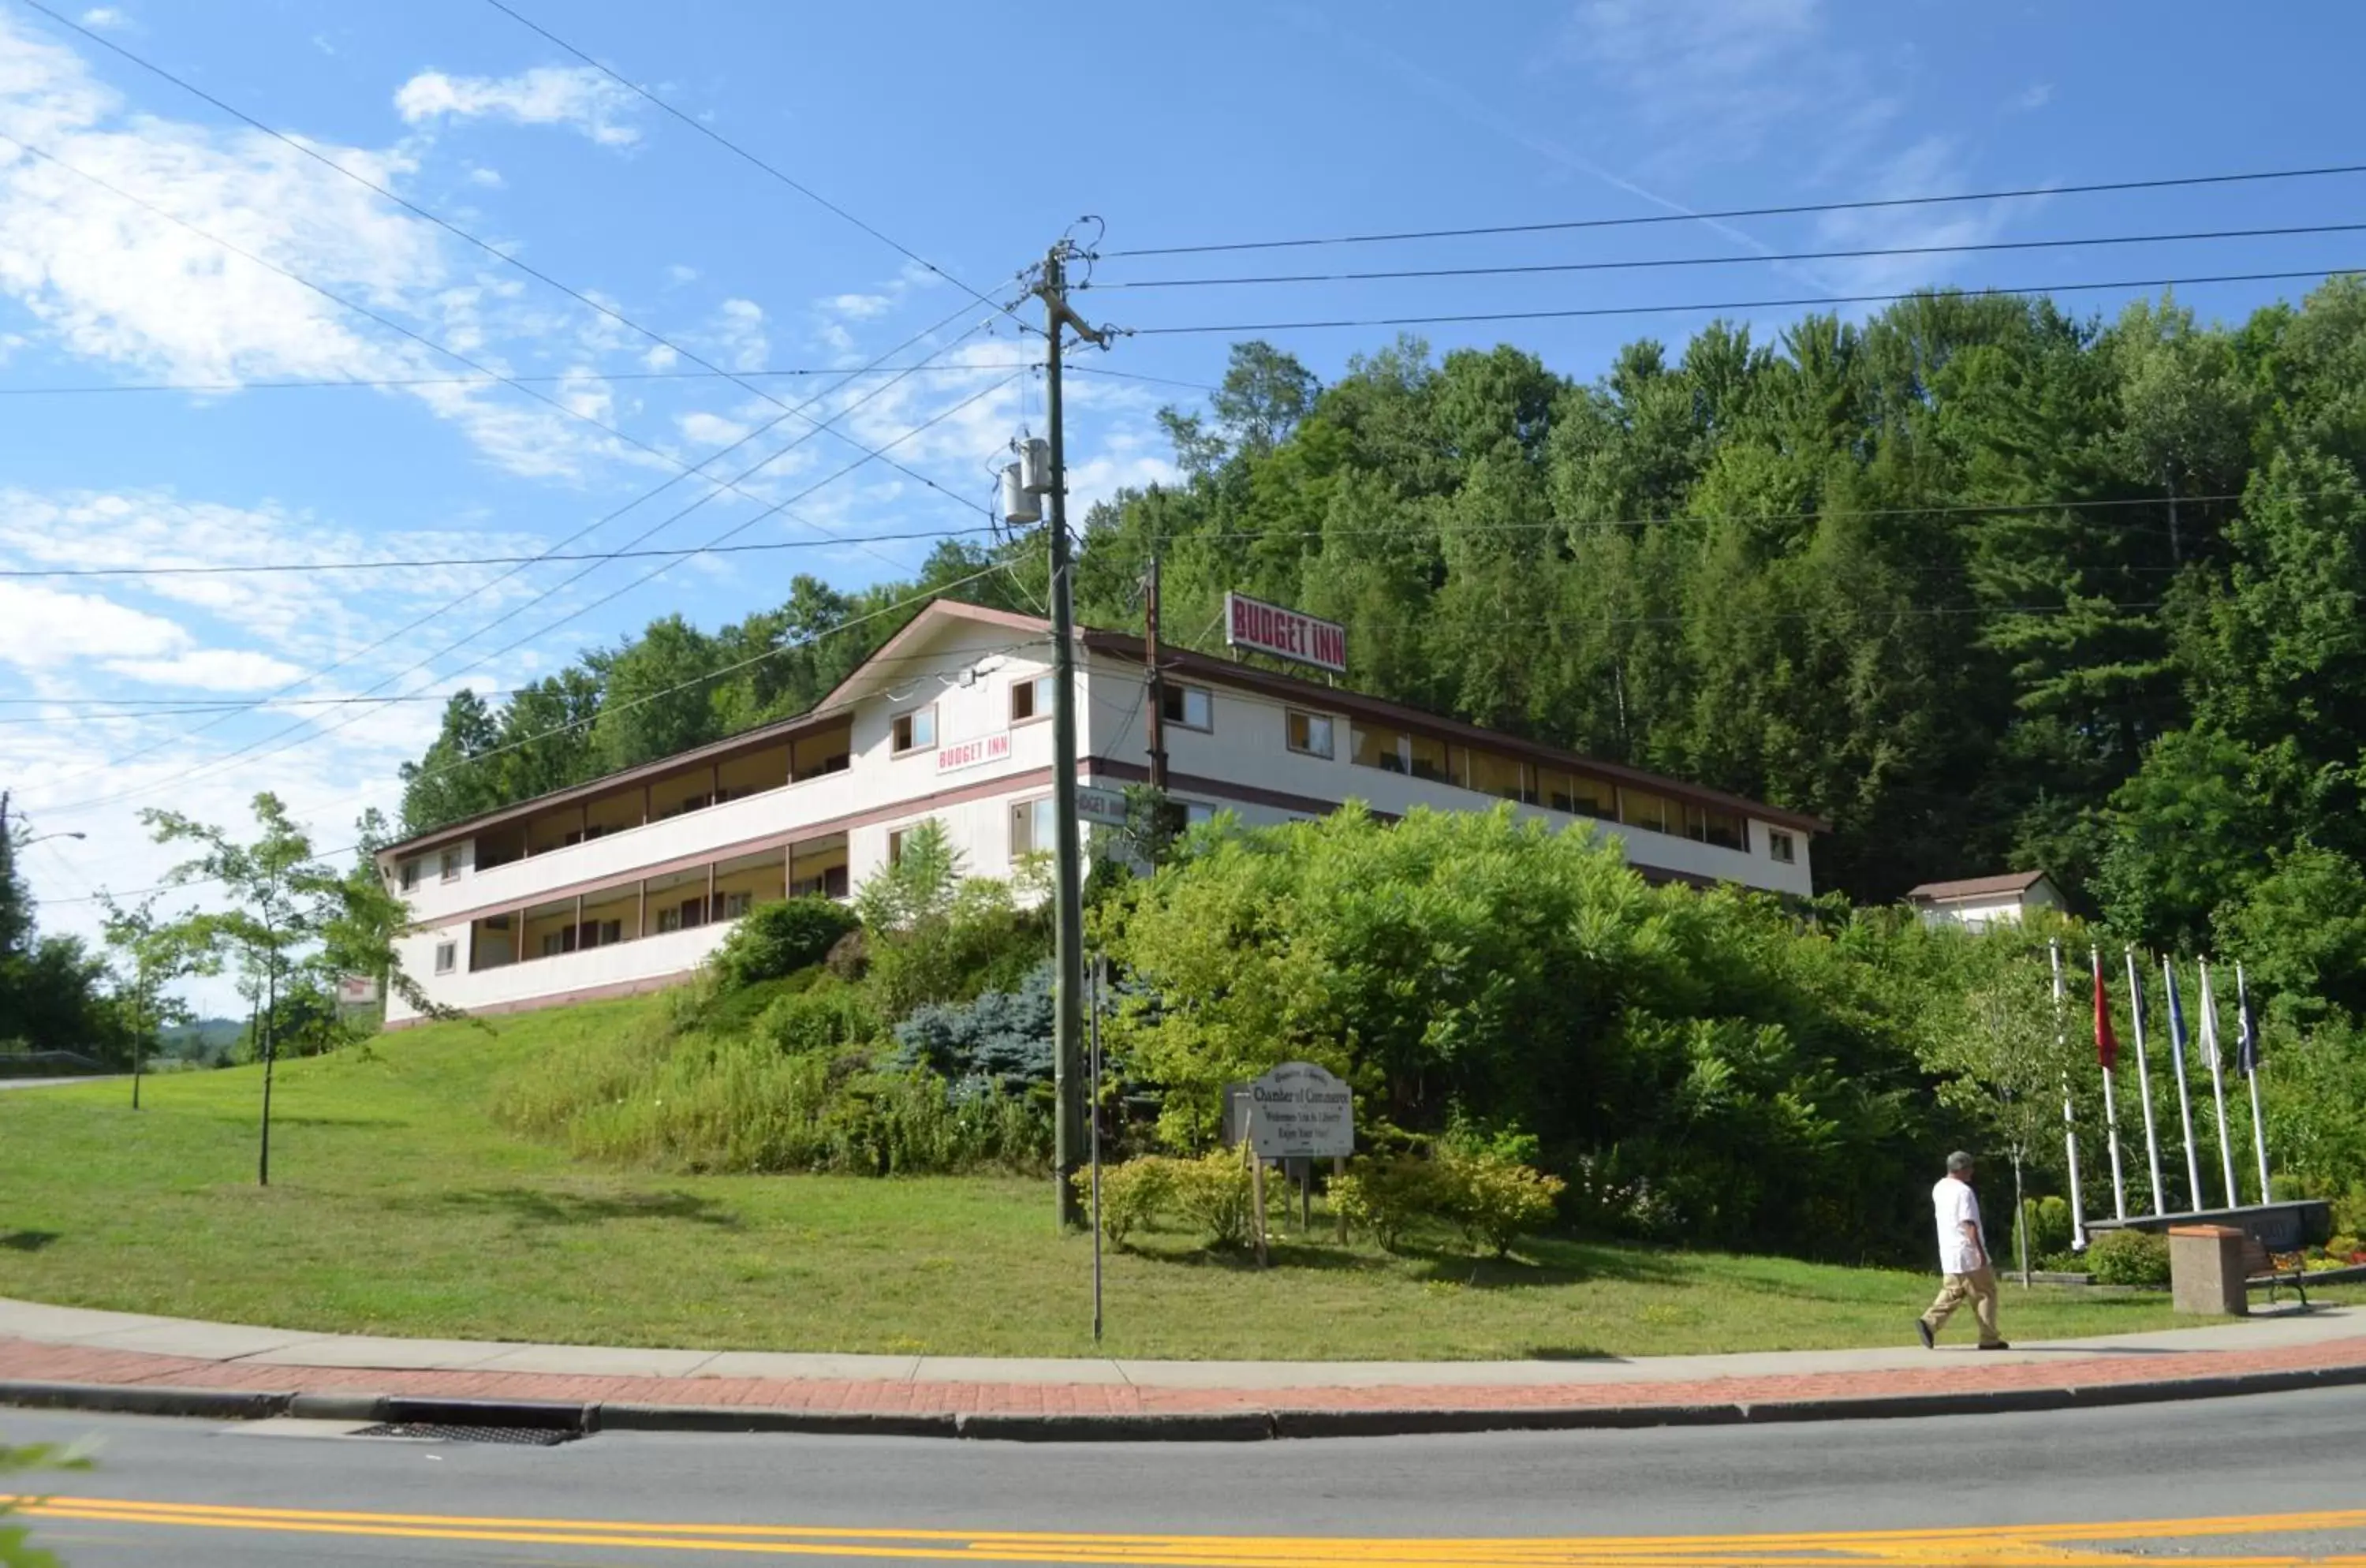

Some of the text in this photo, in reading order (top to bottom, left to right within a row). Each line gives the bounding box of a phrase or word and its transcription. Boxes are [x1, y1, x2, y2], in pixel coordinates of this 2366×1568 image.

[1234, 599, 1345, 666] BUDGET INN
[939, 734, 1008, 769] BUDGET INN
[1254, 1085, 1349, 1104] Chamber of Commerce
